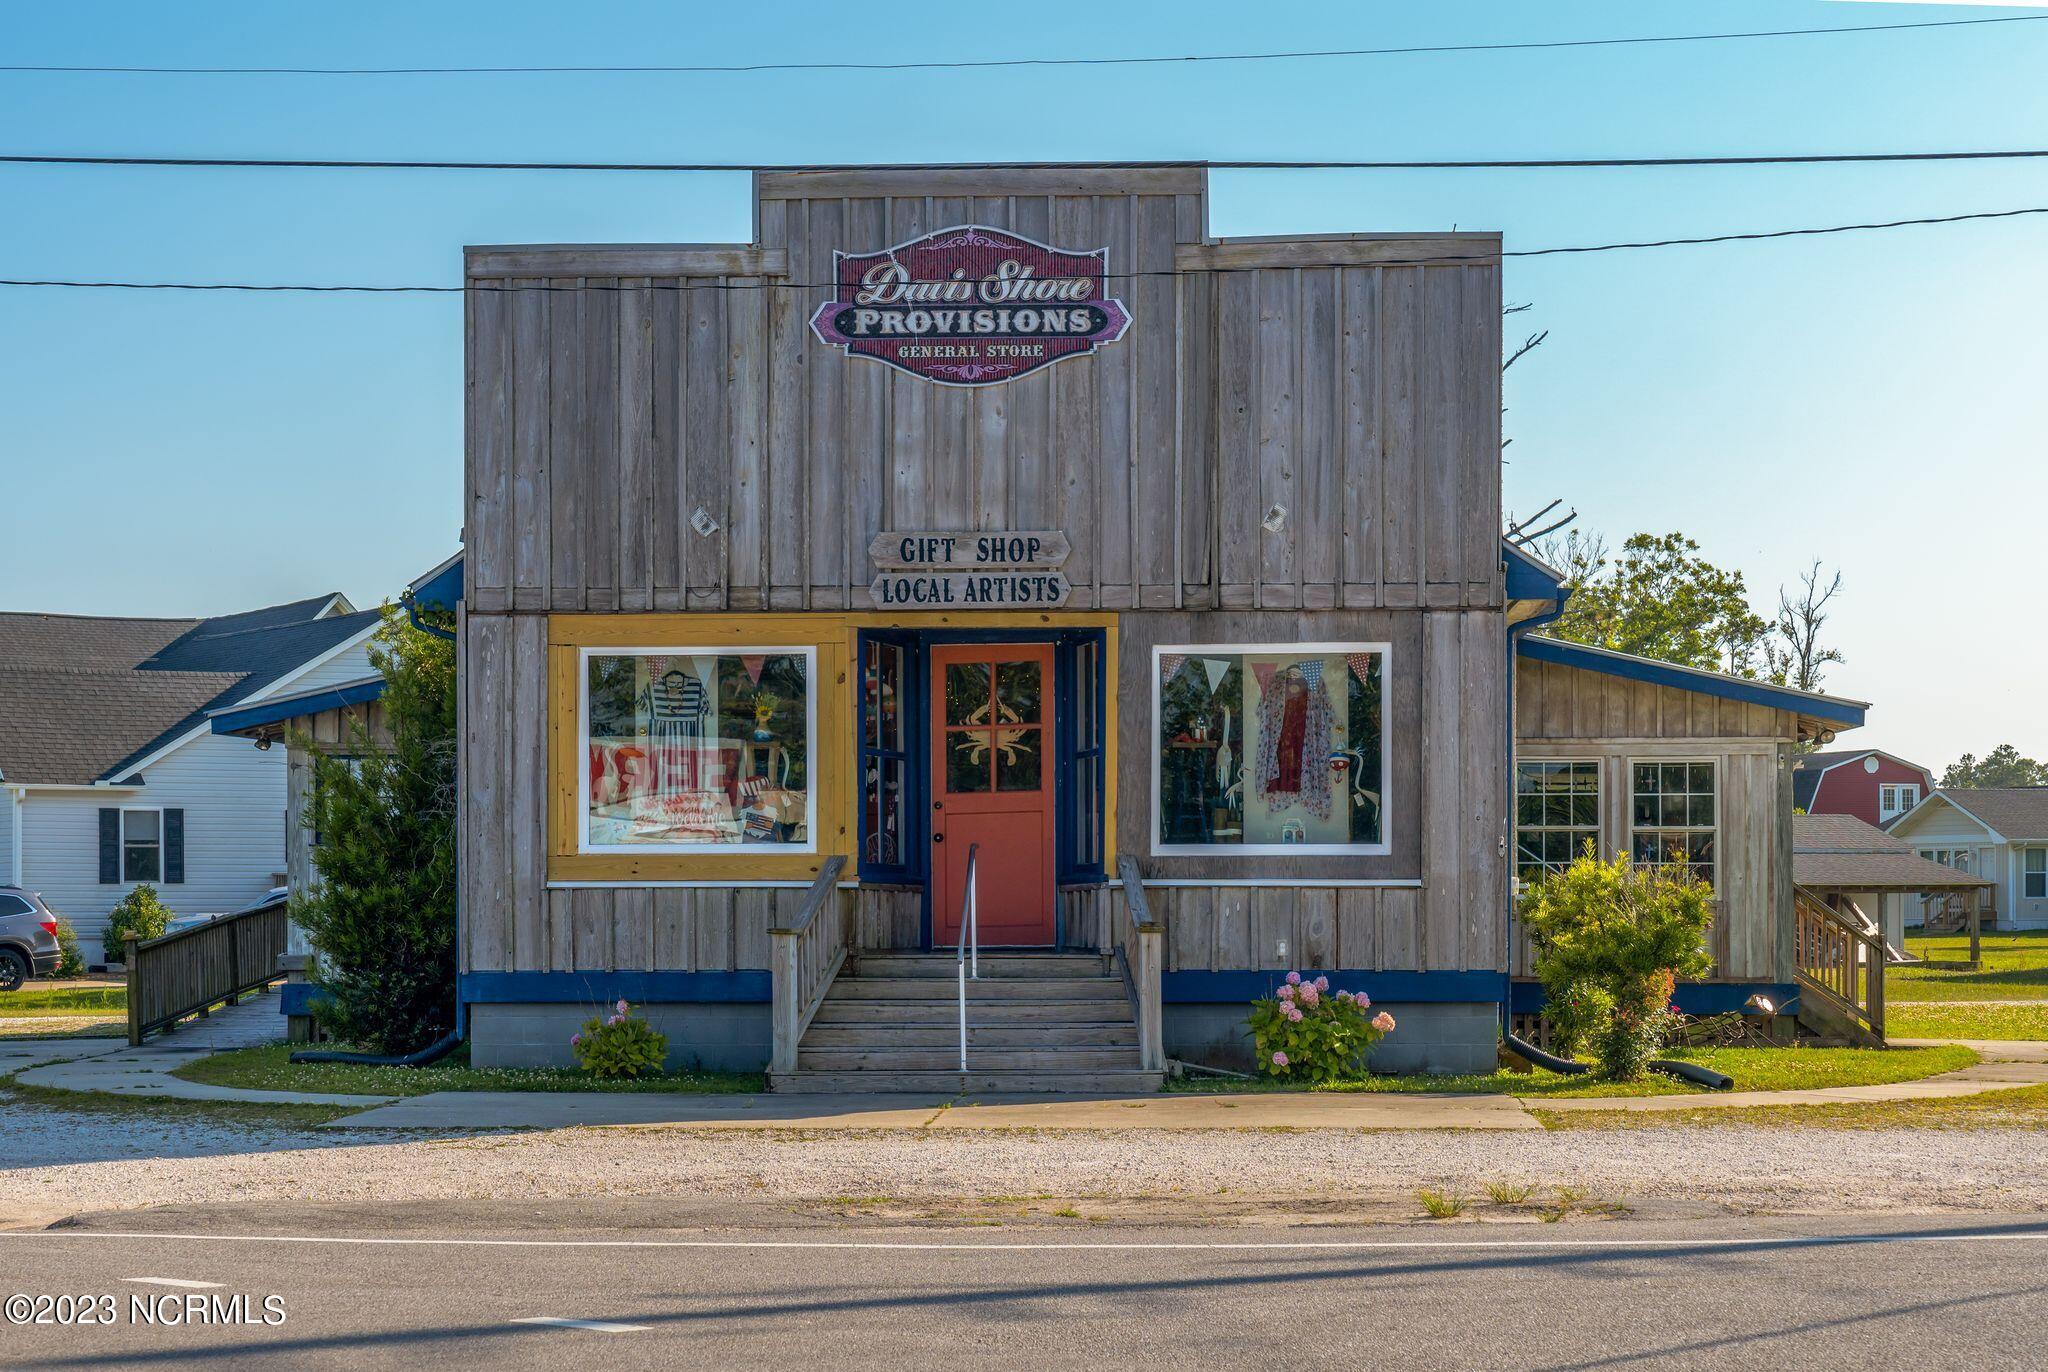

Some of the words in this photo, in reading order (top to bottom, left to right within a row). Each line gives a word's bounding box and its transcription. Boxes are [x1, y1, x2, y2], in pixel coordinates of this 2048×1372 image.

[856, 261, 972, 305] Davis
[979, 259, 1095, 303] Shore
[853, 308, 1092, 335] PROVISIONS
[898, 345, 980, 358] GENERAL
[986, 345, 1044, 358] STORE
[900, 537, 956, 563] GIFT
[976, 537, 1041, 562] SHOP
[882, 577, 954, 603] LOCAL
[963, 577, 1061, 602] ARTISTS
